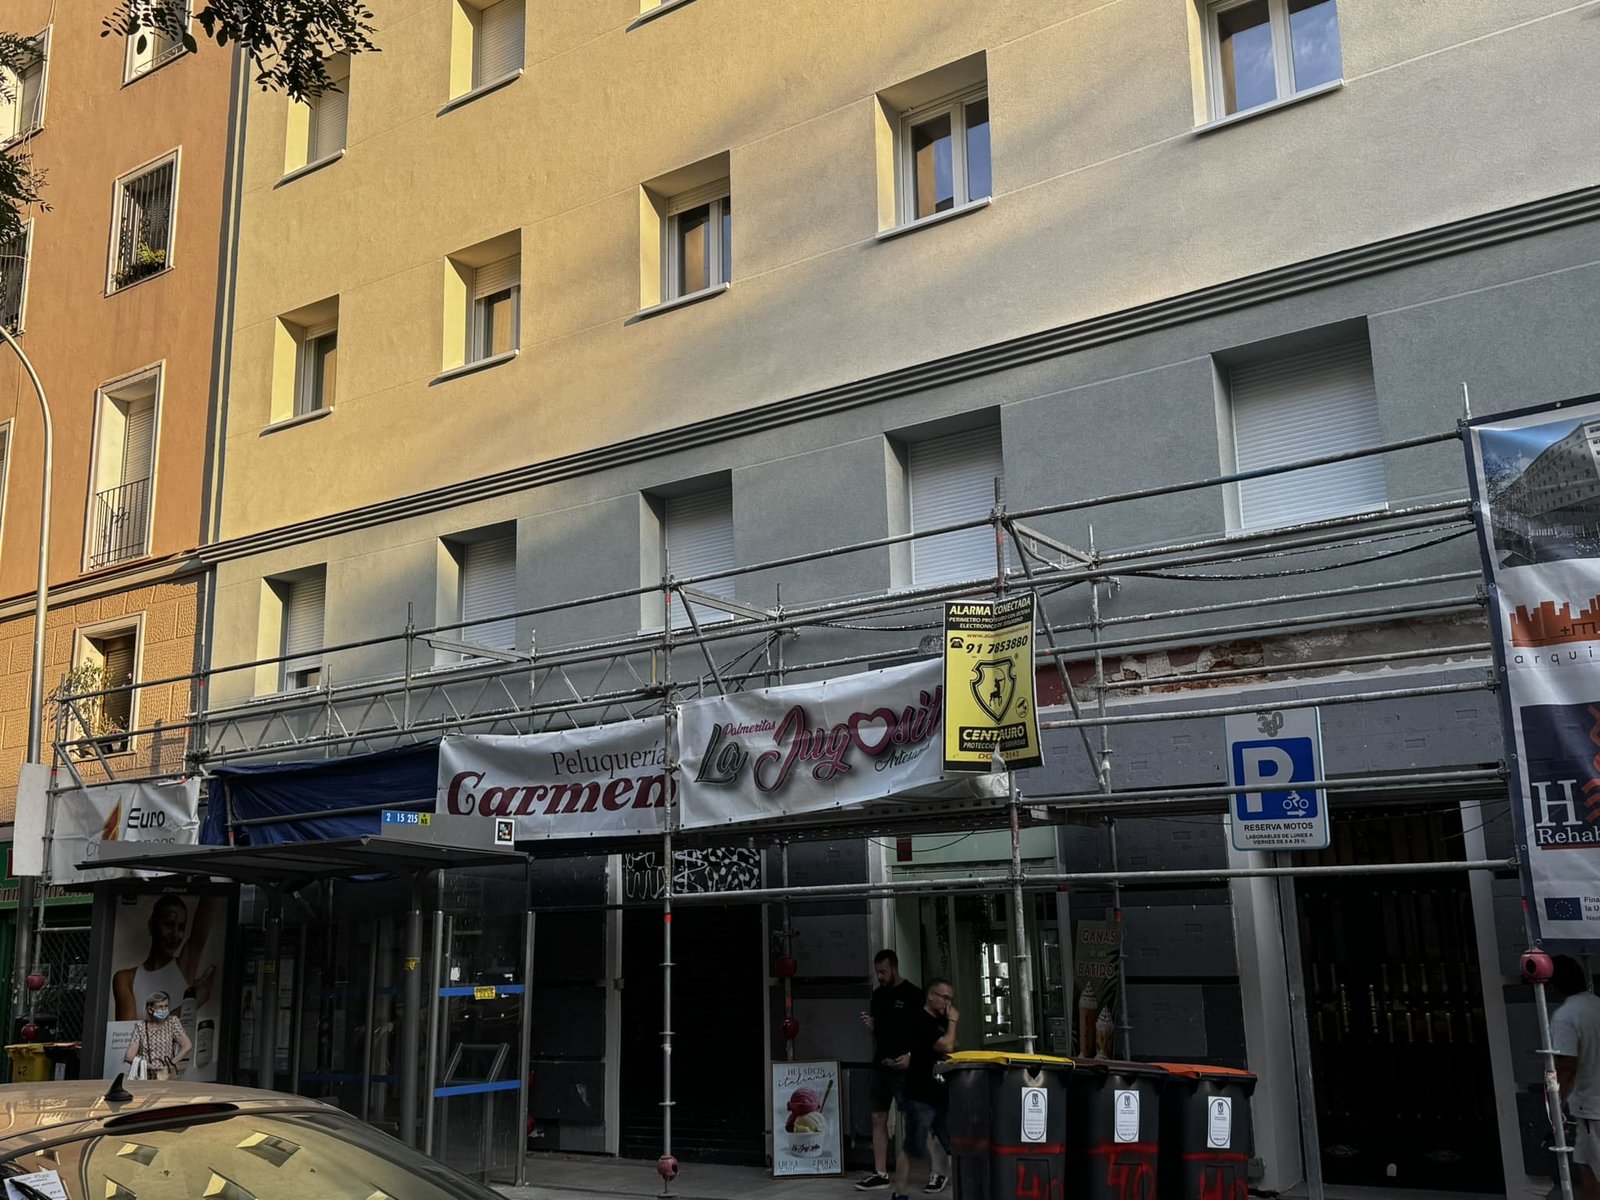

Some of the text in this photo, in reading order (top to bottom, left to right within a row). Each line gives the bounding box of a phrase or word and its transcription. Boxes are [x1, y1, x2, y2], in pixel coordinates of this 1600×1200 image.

[949, 596, 1032, 616] ALARMA CONECTADA
[966, 635, 1029, 655] 91 7853880
[722, 718, 776, 738] Palmeritas
[962, 725, 1025, 742] CENTAURO
[551, 741, 667, 779] Peluquería
[694, 723, 749, 785] La
[1242, 746, 1294, 813] P
[447, 771, 678, 817] Carmen
[127, 807, 165, 829] Euro
[386, 812, 418, 823] 2 15 215
[1244, 822, 1314, 832] RESERVA MOTOS
